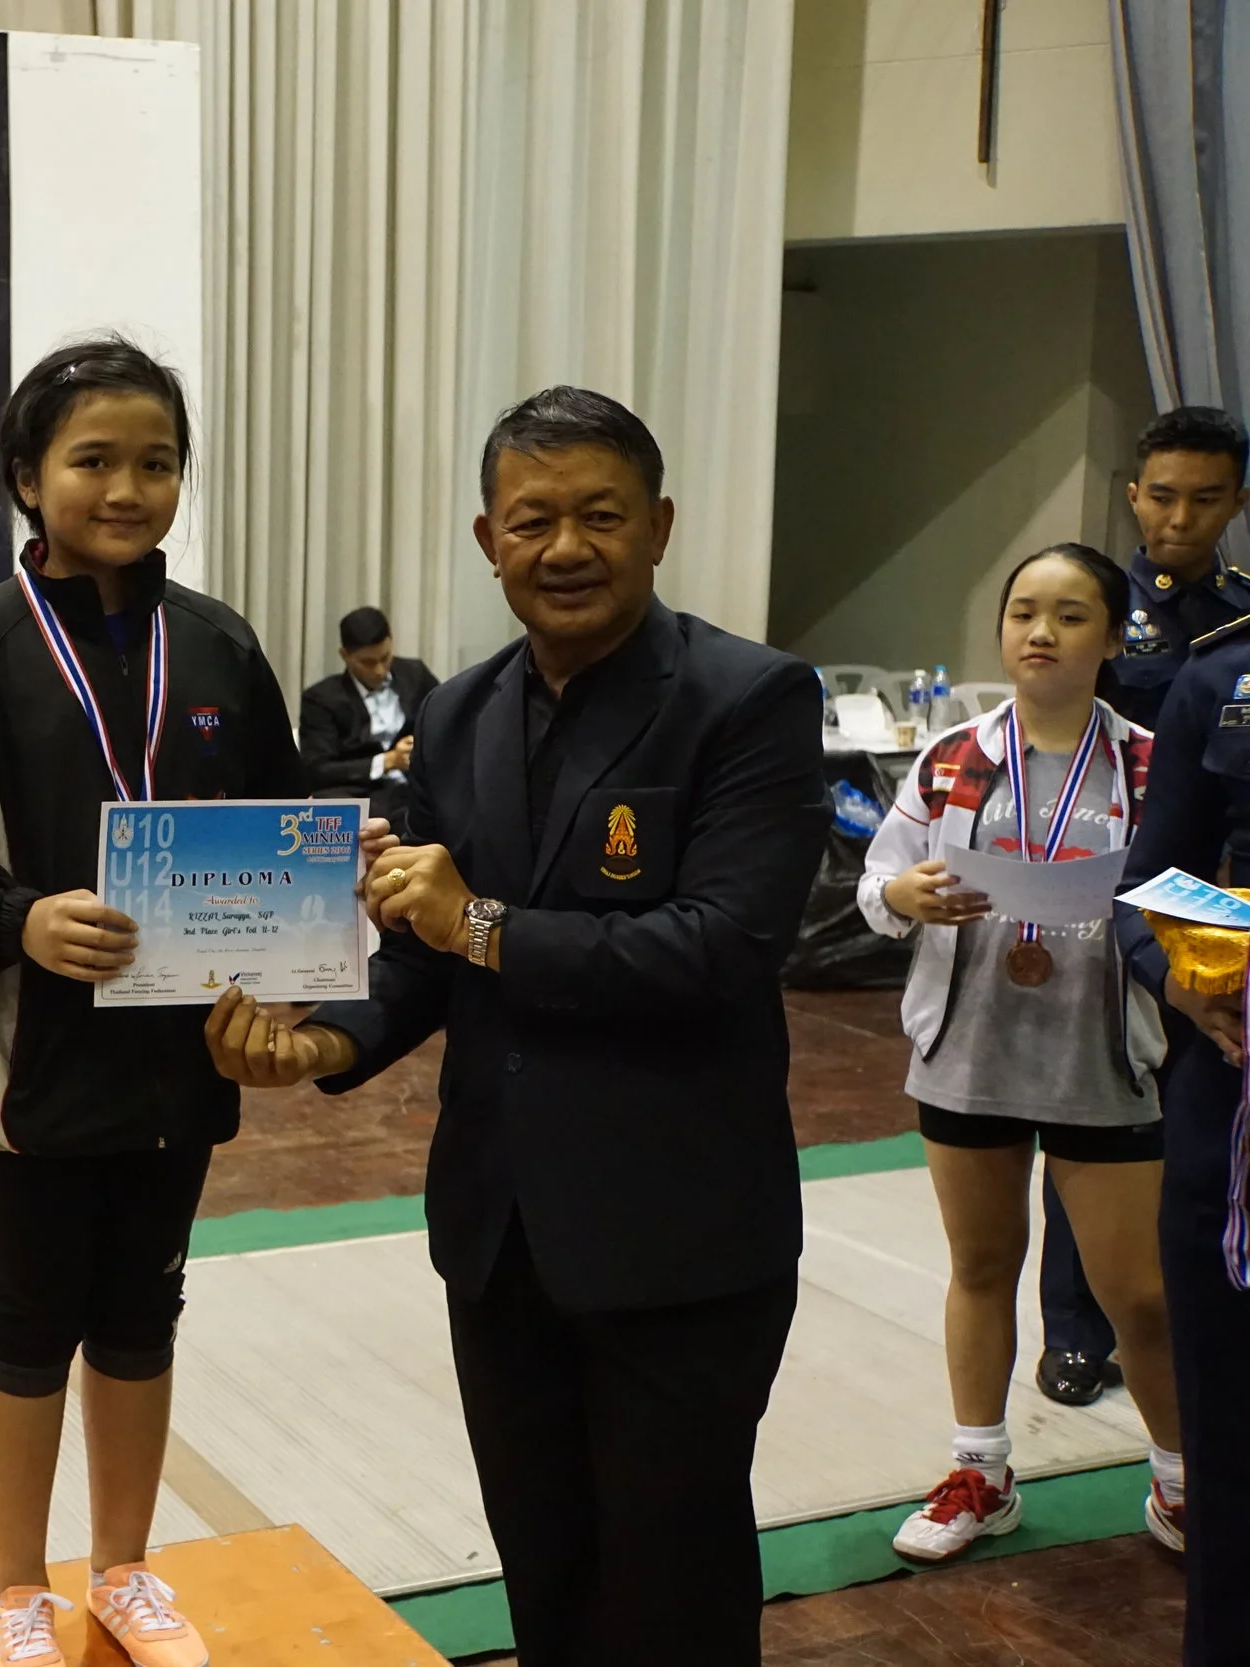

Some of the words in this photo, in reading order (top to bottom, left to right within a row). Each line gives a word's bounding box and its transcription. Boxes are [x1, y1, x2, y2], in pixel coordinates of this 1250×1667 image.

[191, 715, 220, 727] YMCA
[315, 816, 342, 831] TFF
[302, 831, 353, 845] MINIME
[110, 851, 173, 888] U12
[171, 871, 292, 887] DIPLOMA
[205, 895, 247, 905] Awarded
[249, 896, 259, 905] to
